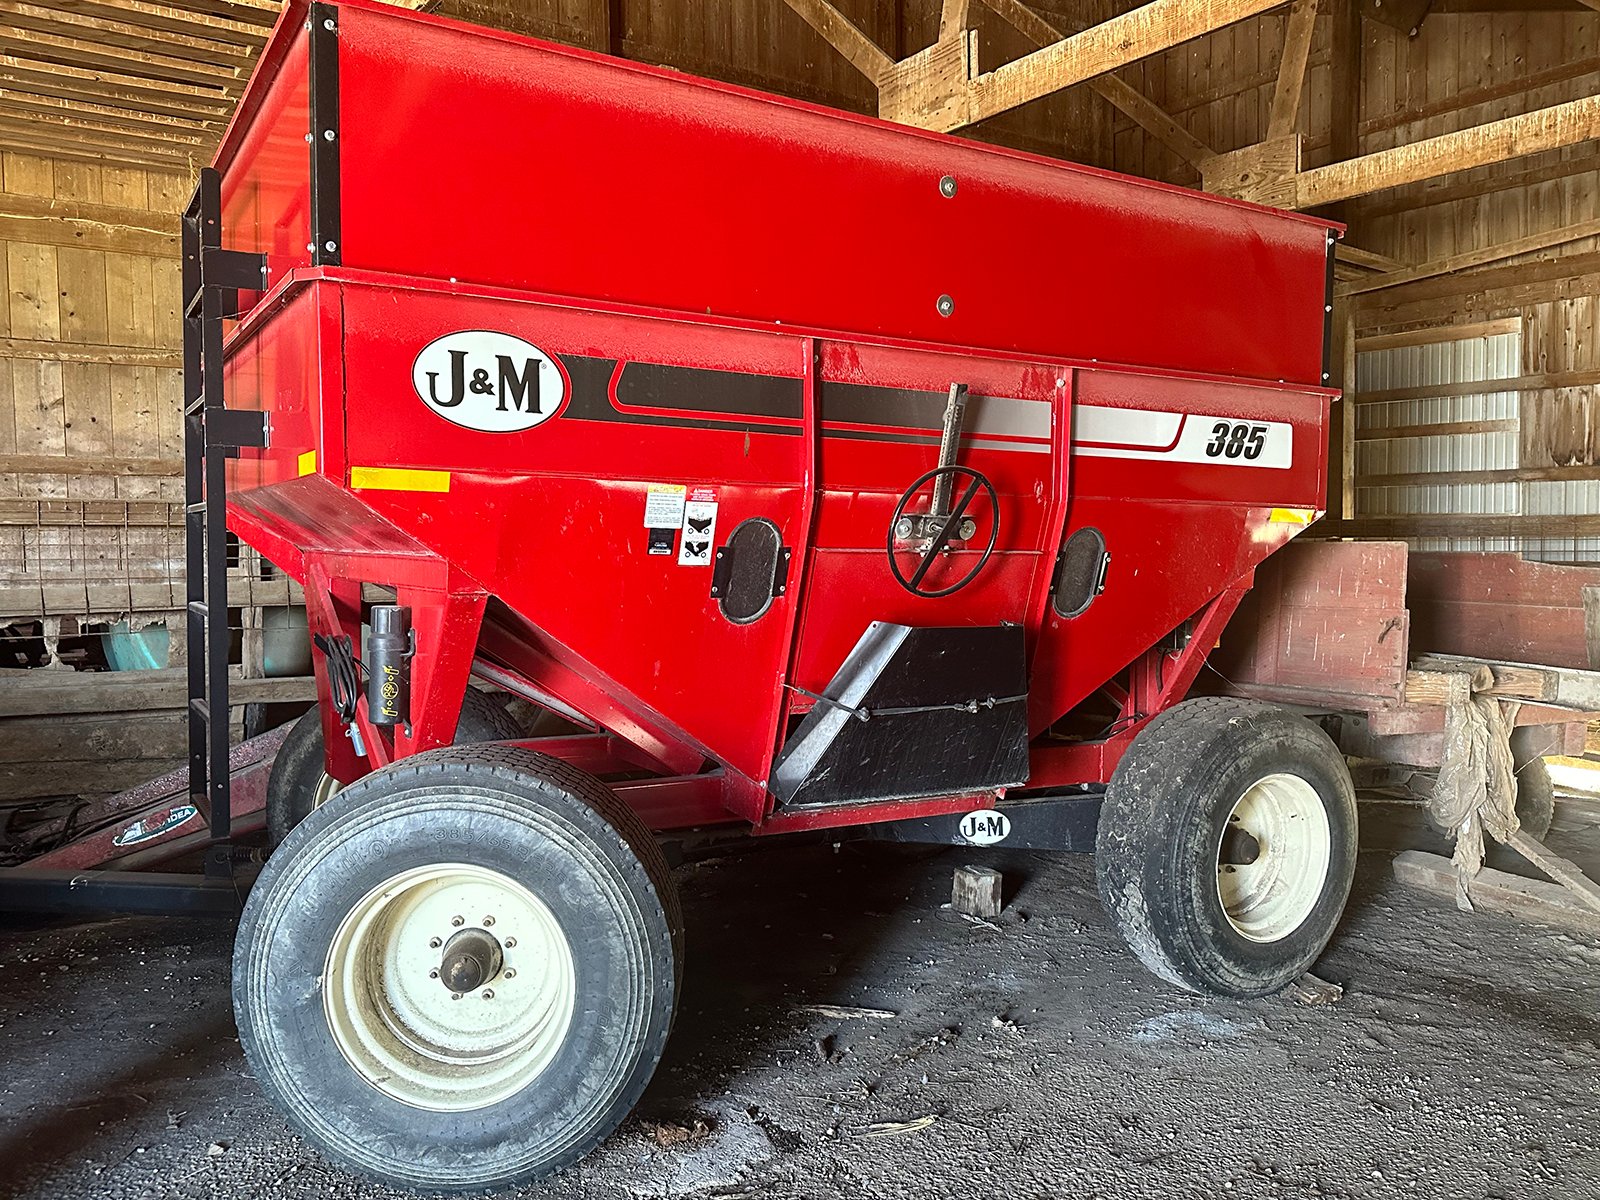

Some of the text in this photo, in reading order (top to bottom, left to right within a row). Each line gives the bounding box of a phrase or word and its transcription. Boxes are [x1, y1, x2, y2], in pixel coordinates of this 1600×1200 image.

[425, 349, 543, 414] J&M
[1206, 421, 1269, 460] 385
[433, 826, 513, 852] 385/65
[962, 816, 1005, 838] J&M
